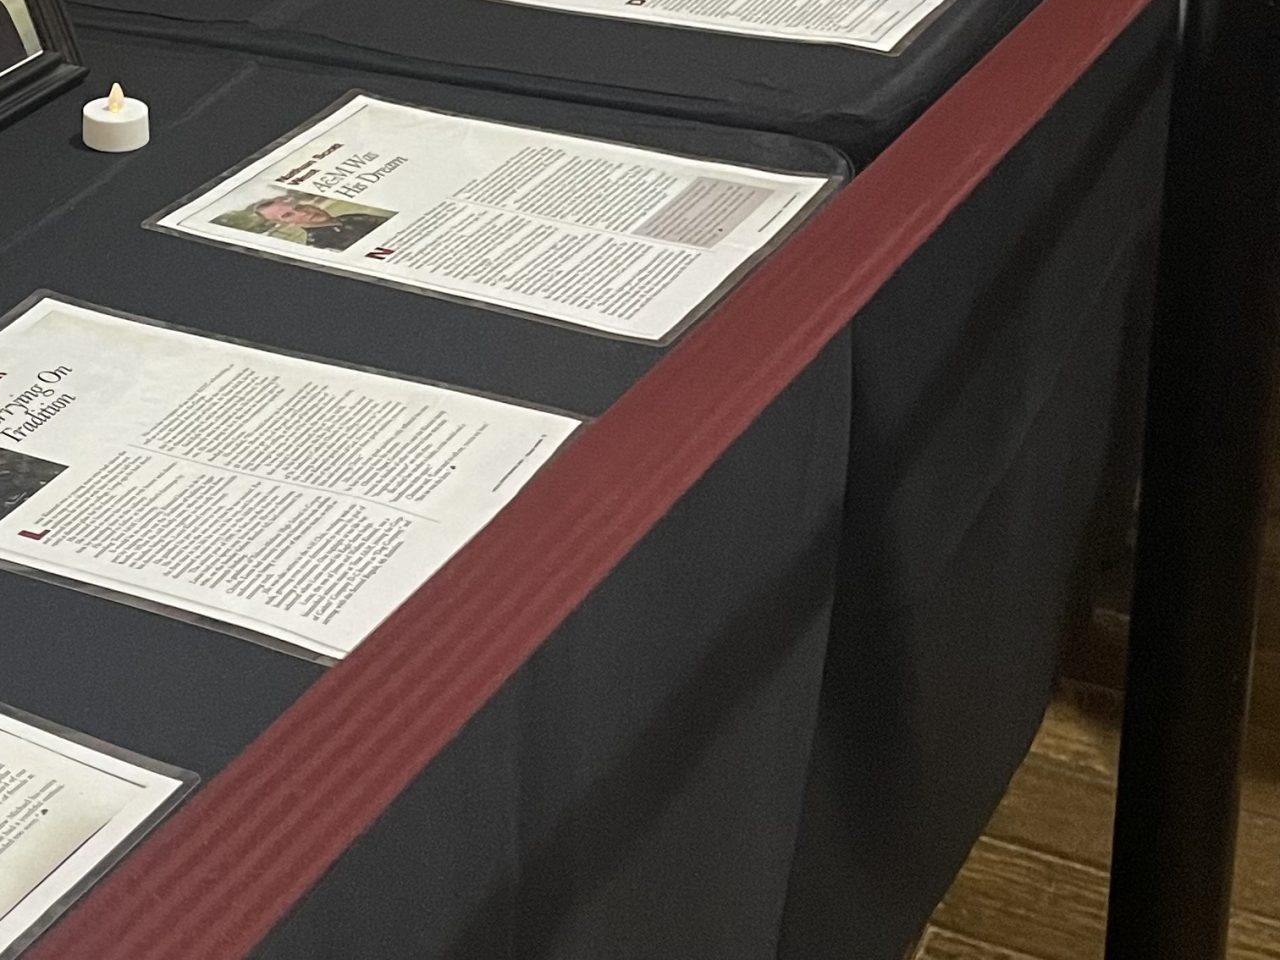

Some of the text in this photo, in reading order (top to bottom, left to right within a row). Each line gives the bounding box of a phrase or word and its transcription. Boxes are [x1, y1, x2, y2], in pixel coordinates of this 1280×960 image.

[312, 152, 379, 192] A&M Was
[334, 156, 408, 198] His Dream
[365, 247, 395, 260] N
[37, 366, 72, 383] On
[17, 529, 51, 541] L
